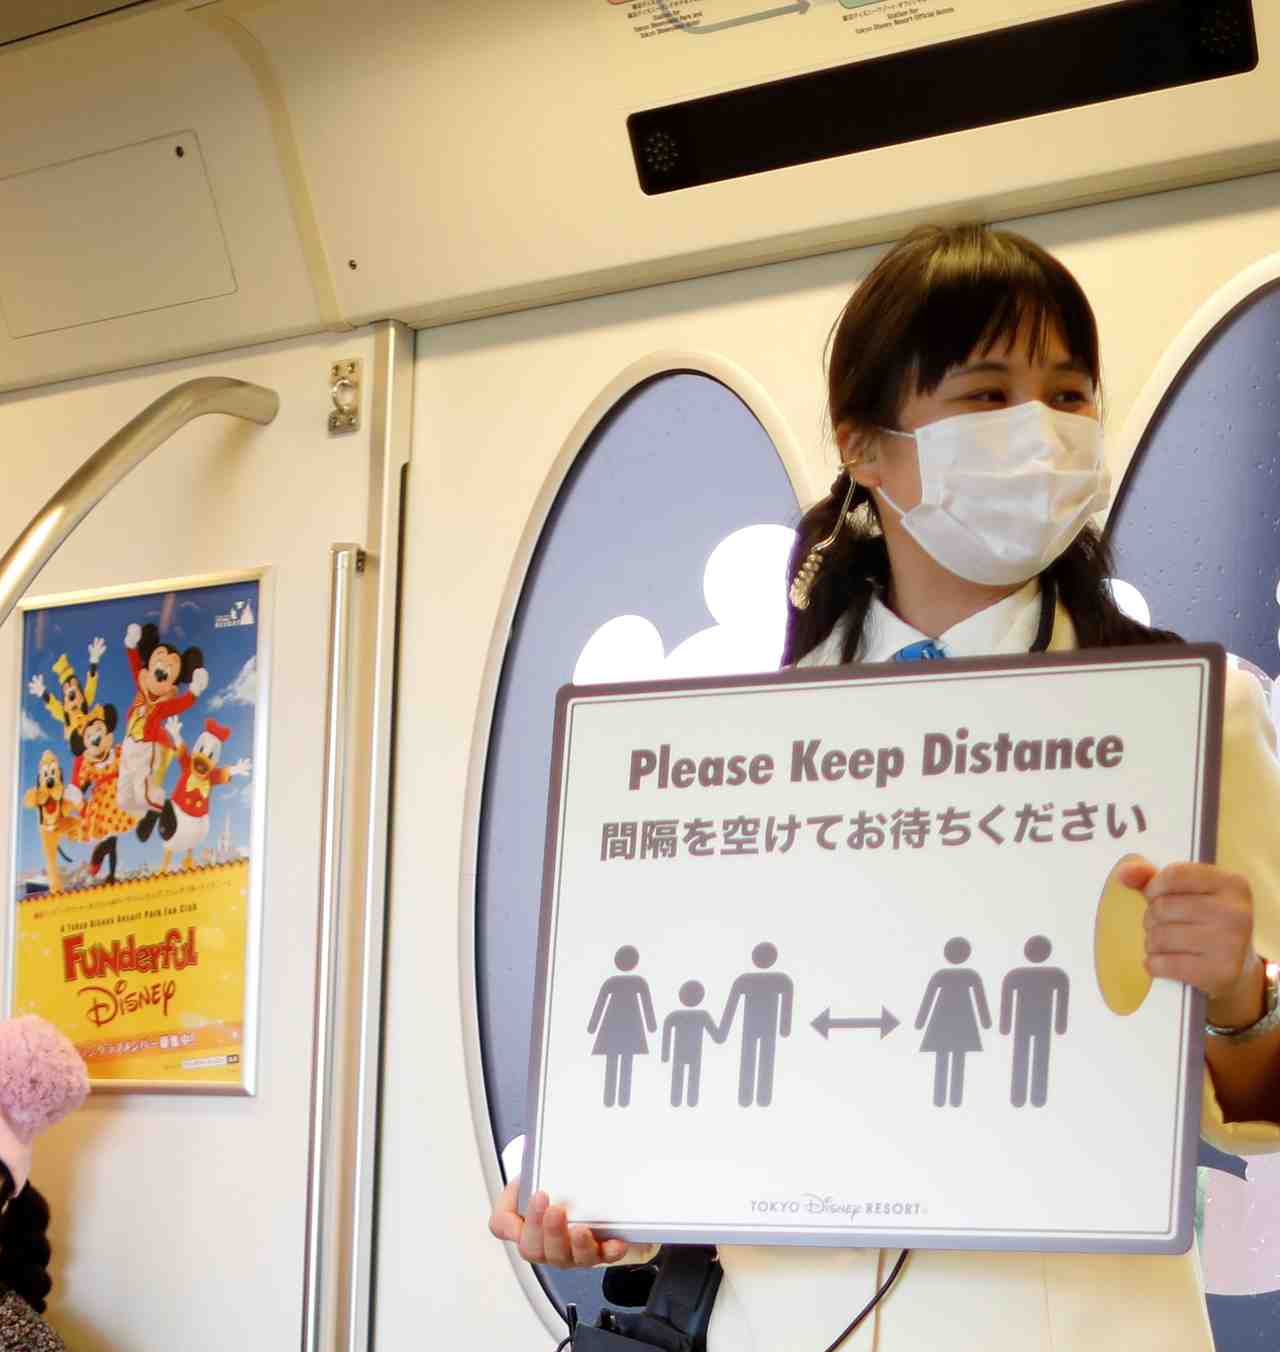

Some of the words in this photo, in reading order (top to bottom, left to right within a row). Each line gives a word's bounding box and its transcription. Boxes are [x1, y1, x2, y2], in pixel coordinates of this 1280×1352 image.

[628, 743, 775, 791] Please
[789, 739, 905, 788] Keep
[921, 727, 1124, 777] Distance
[600, 801, 1148, 862] 間隔を空けてお待ちください
[750, 1199, 800, 1214] TOKYO
[865, 1201, 920, 1216] RESORT
